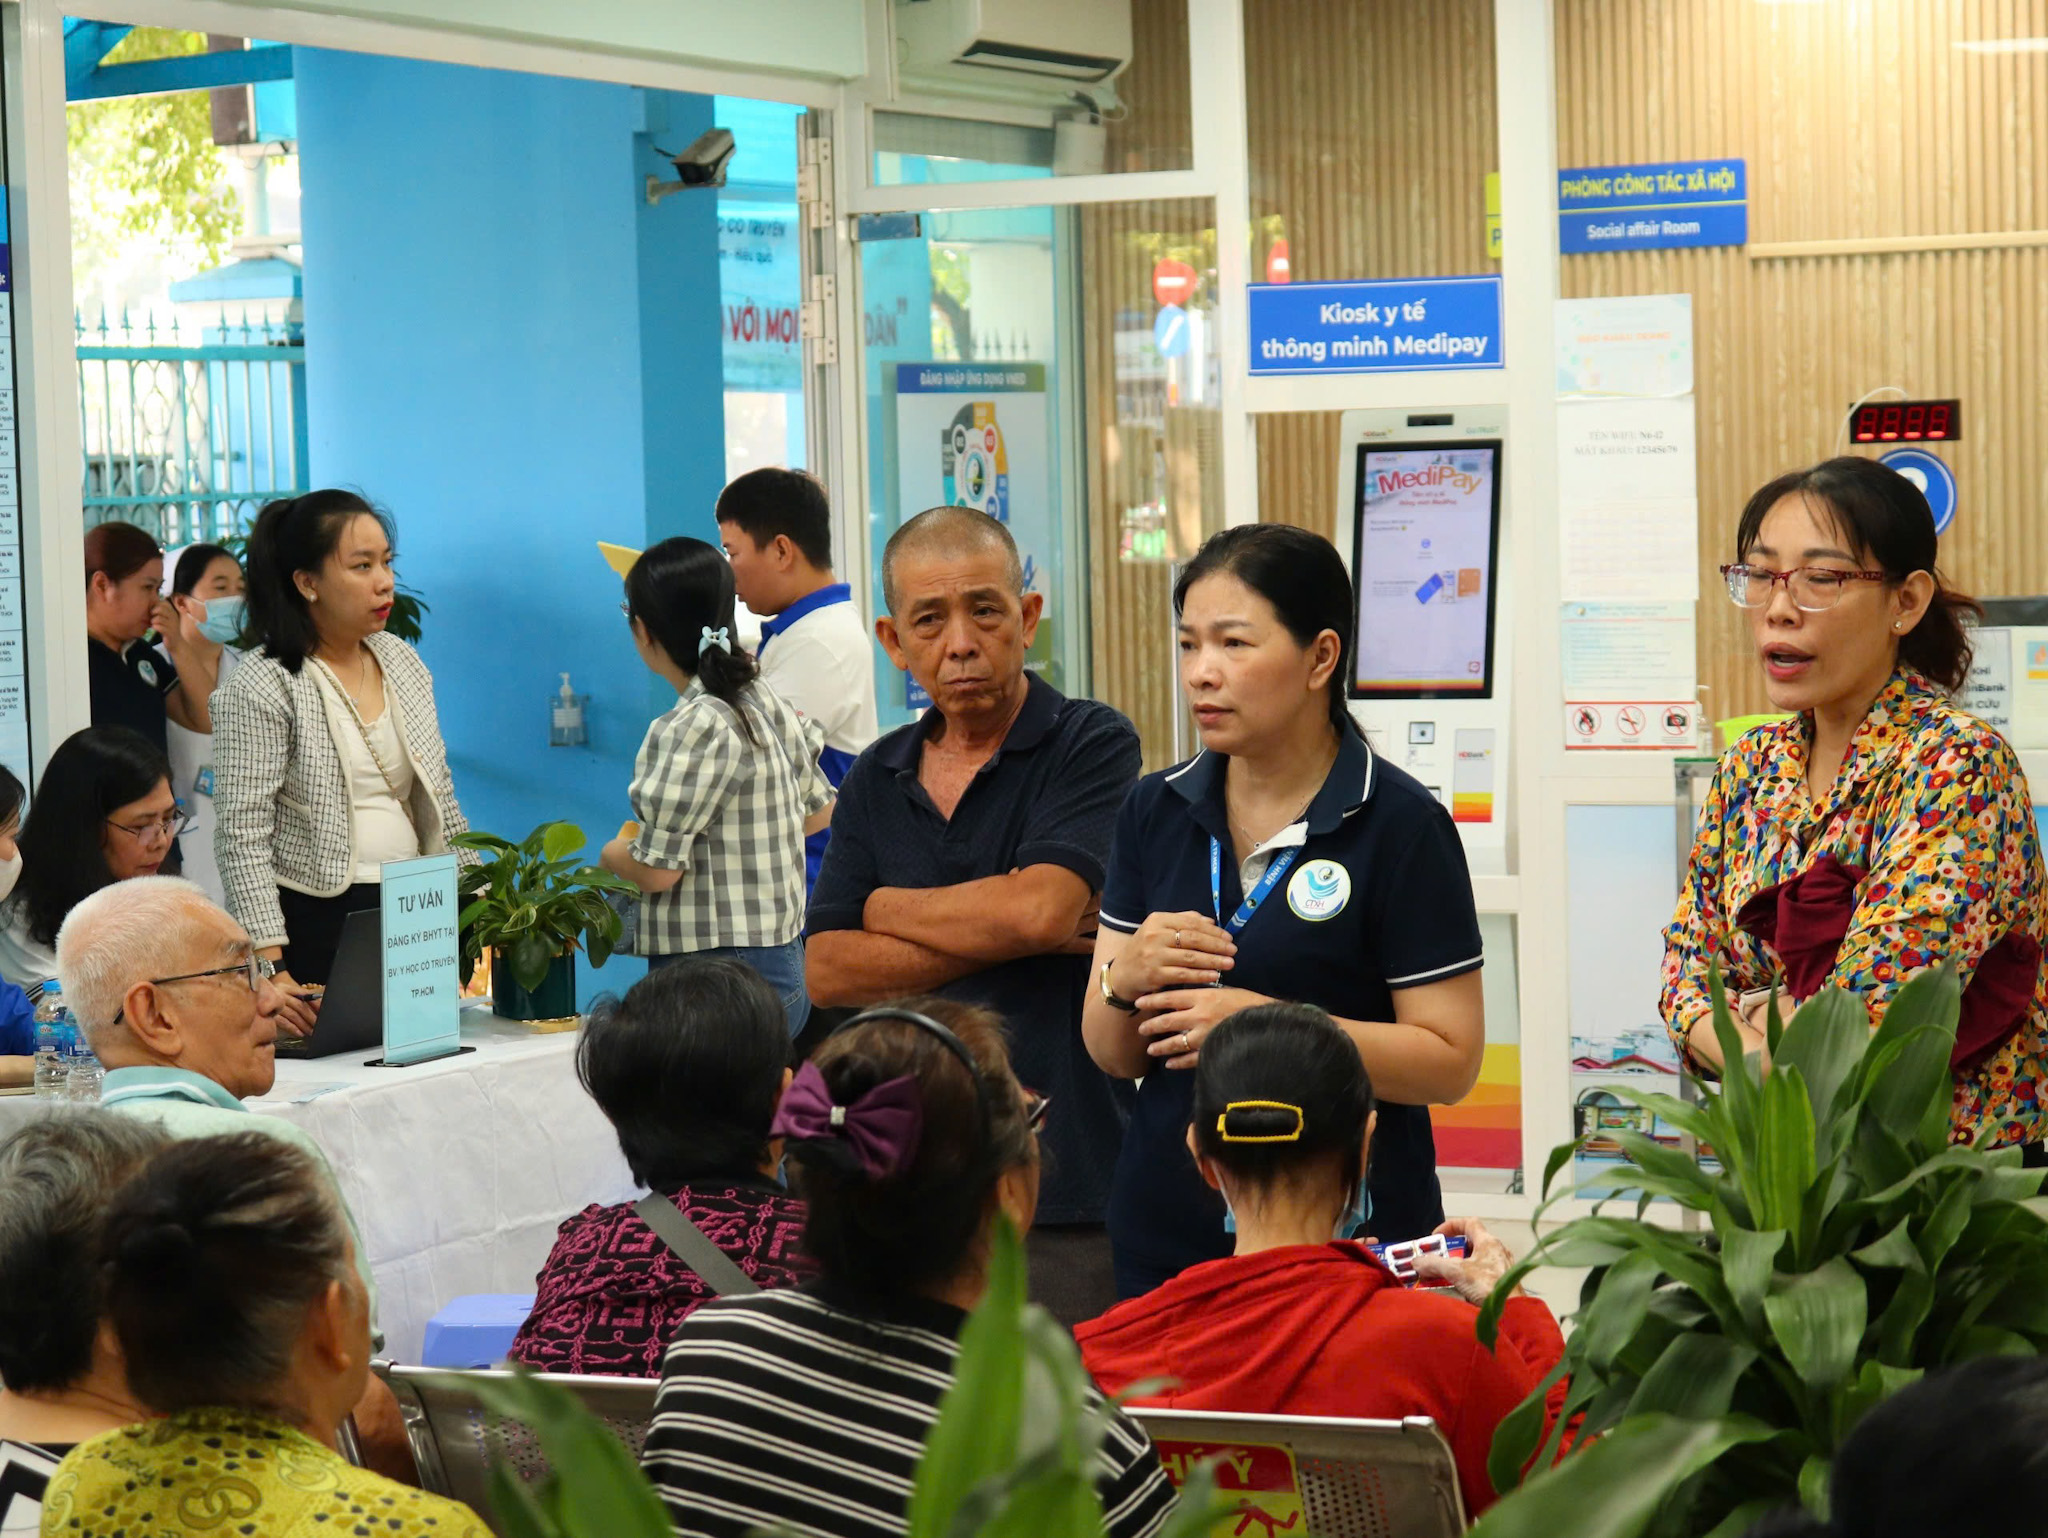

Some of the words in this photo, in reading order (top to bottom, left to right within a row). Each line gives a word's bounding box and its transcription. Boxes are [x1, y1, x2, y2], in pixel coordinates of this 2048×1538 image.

[1561, 175, 1611, 198] PHÒNG
[1613, 173, 1654, 195] CÔNG
[1656, 171, 1684, 192] TÁC
[1686, 168, 1706, 191] XÃ
[1708, 166, 1736, 194] HỘI
[1587, 222, 1625, 239] Social
[1627, 220, 1660, 236] affair
[1663, 219, 1701, 235] Room
[1321, 303, 1380, 324] Kiosk
[1384, 306, 1398, 327] y
[1403, 298, 1427, 321] tế
[766, 308, 799, 353] MỌI
[1261, 338, 1326, 362] thông
[1331, 335, 1388, 356] minh
[1394, 332, 1488, 357] Medipay
[1378, 465, 1483, 495] MediPay
[398, 895, 416, 914] TƯ
[418, 887, 443, 910] VẤN
[388, 934, 409, 948] ĐĂNG
[423, 927, 442, 942] BHYT
[444, 926, 455, 939] TẠI
[388, 968, 400, 978] BV.
[400, 965, 405, 975] Y
[406, 962, 419, 976] HỌC
[411, 985, 435, 998] TP.HCM
